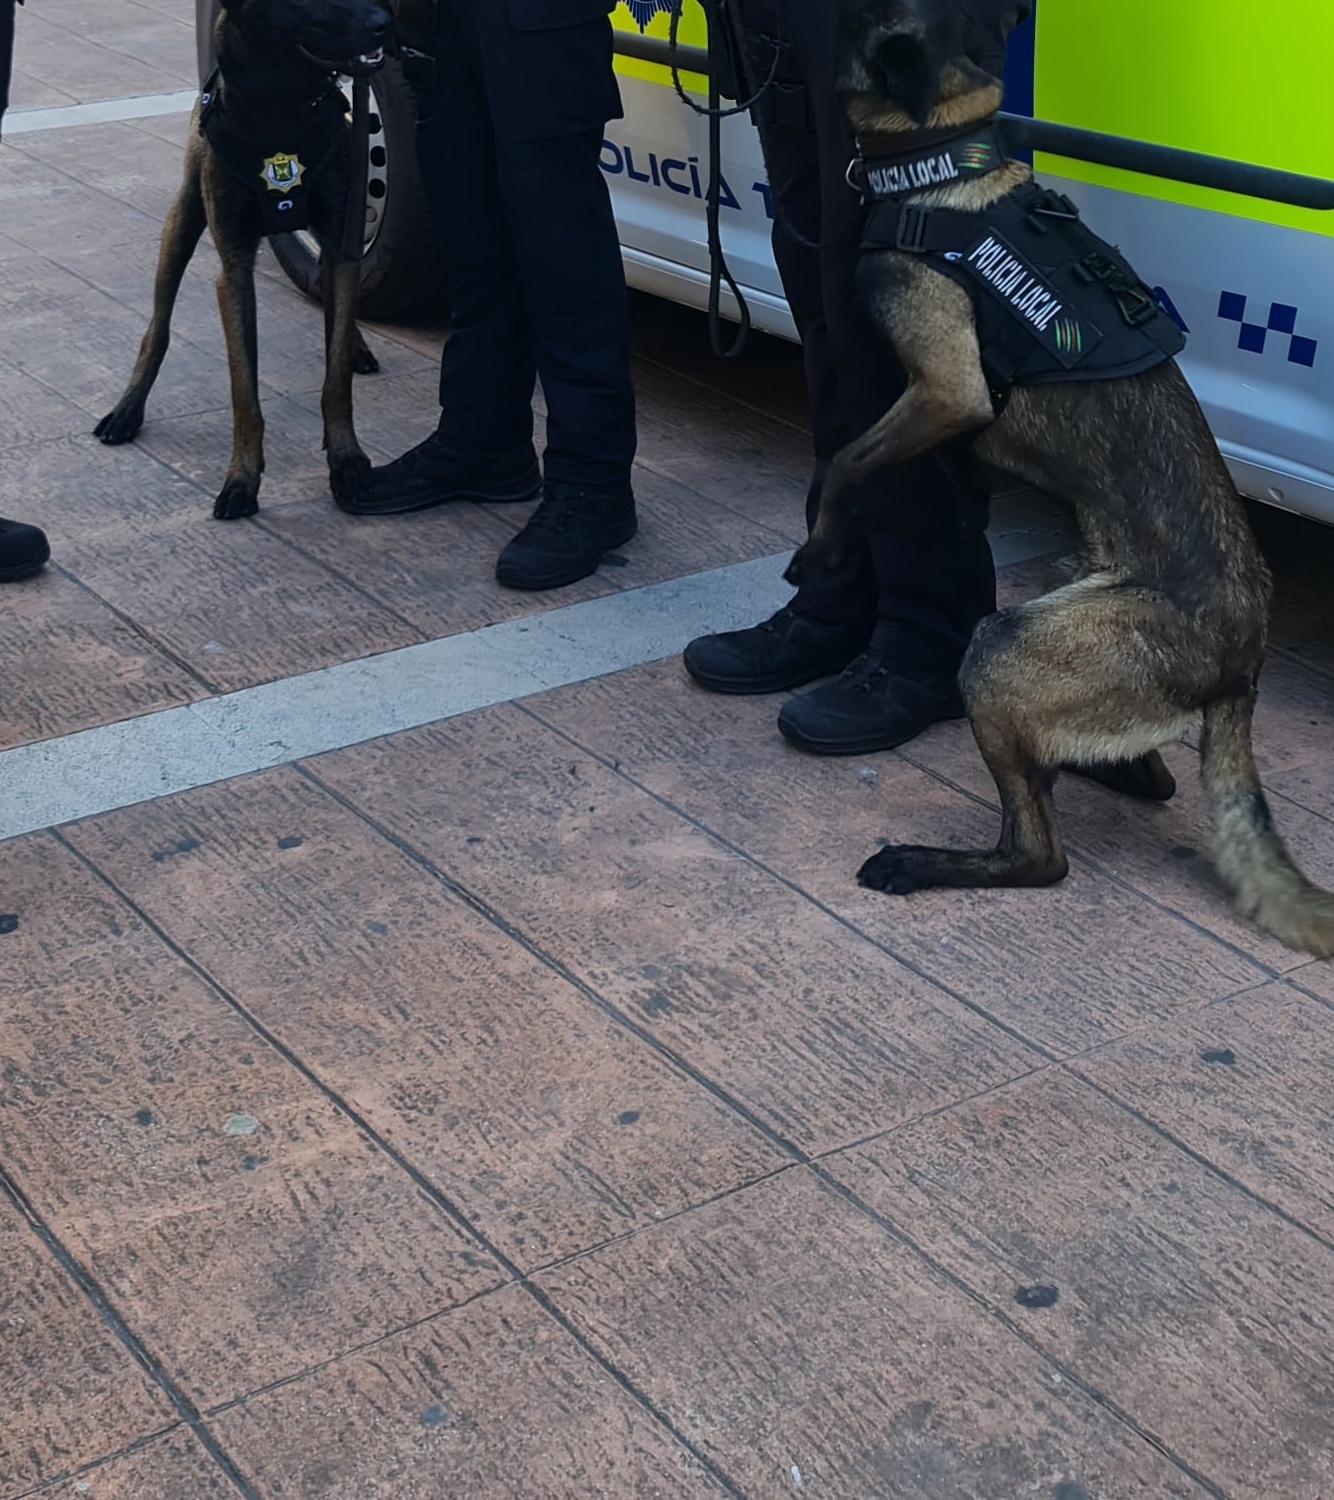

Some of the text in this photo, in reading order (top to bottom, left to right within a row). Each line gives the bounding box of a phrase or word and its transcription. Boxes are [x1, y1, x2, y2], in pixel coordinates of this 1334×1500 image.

[597, 139, 743, 211] OLICÍA
[908, 152, 959, 188] LOCAL
[968, 236, 1063, 332] POLICIA LOCAL
